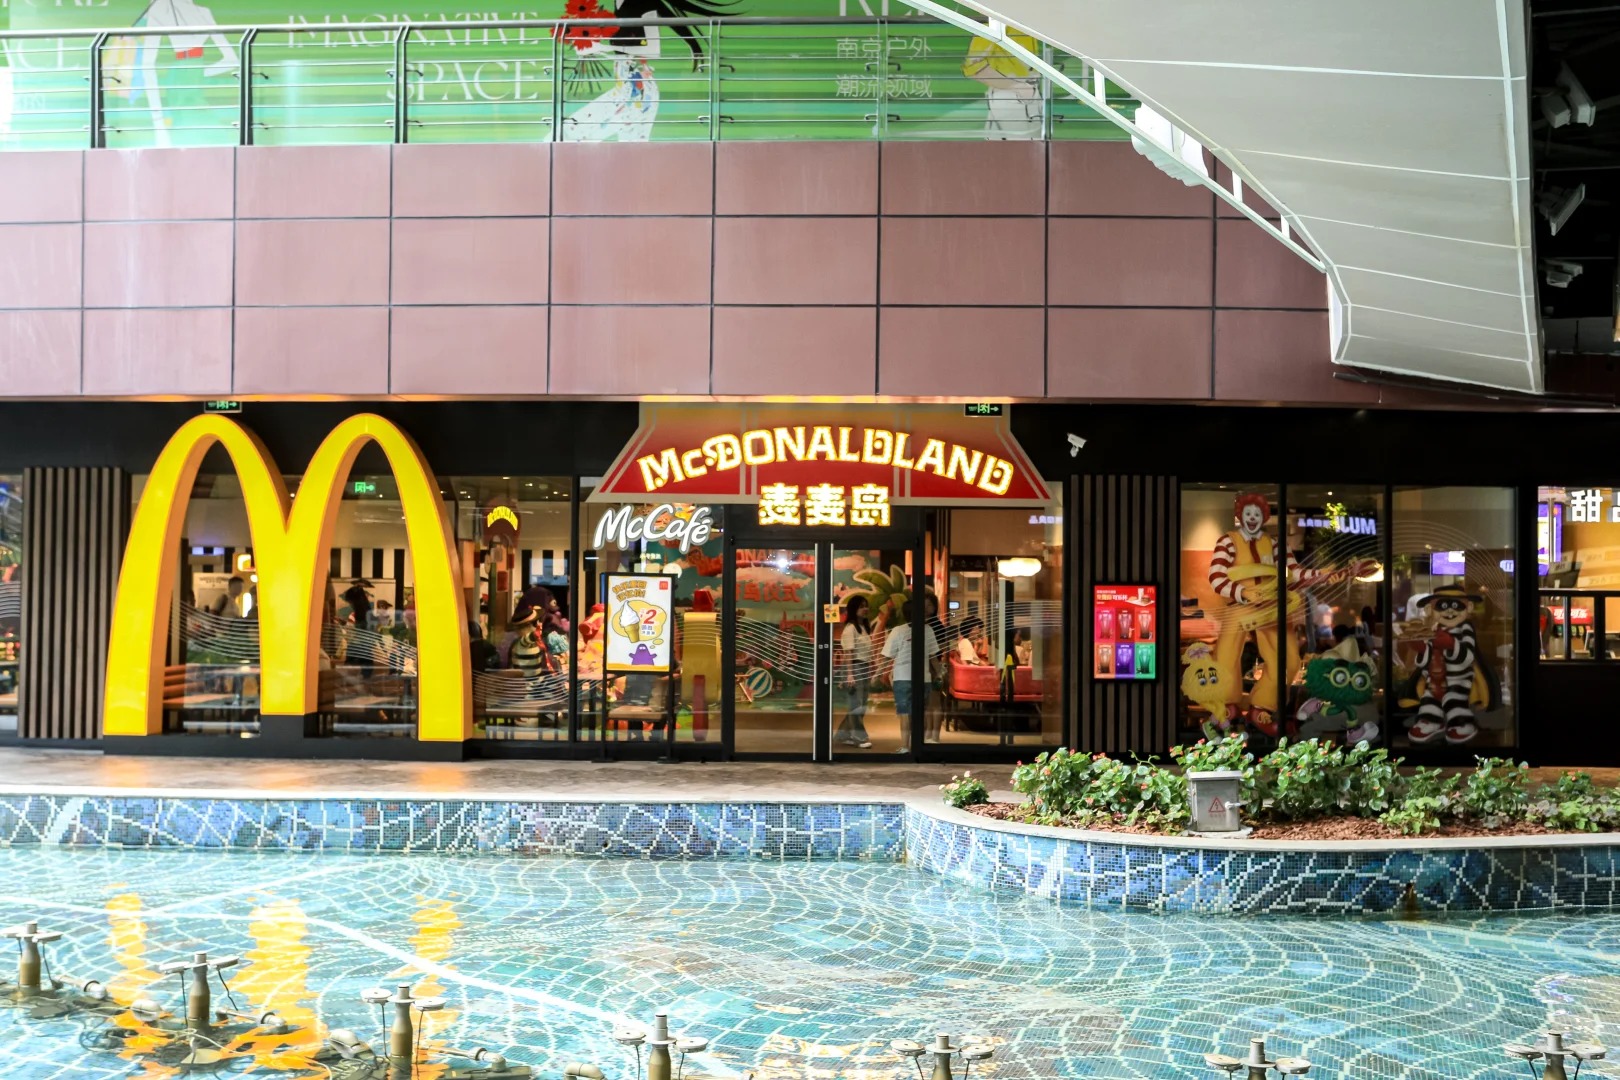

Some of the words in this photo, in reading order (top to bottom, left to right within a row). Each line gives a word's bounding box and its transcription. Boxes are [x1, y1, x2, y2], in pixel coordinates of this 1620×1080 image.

[288, 12, 539, 48] IMAGINATIVE
[836, 38, 932, 60] 南京户外
[386, 61, 538, 101] SPACE
[836, 74, 932, 98] 潮流领域
[758, 482, 892, 527] 麦麦岛
[1571, 489, 1620, 522] 甜
[593, 503, 711, 553] McCafé
